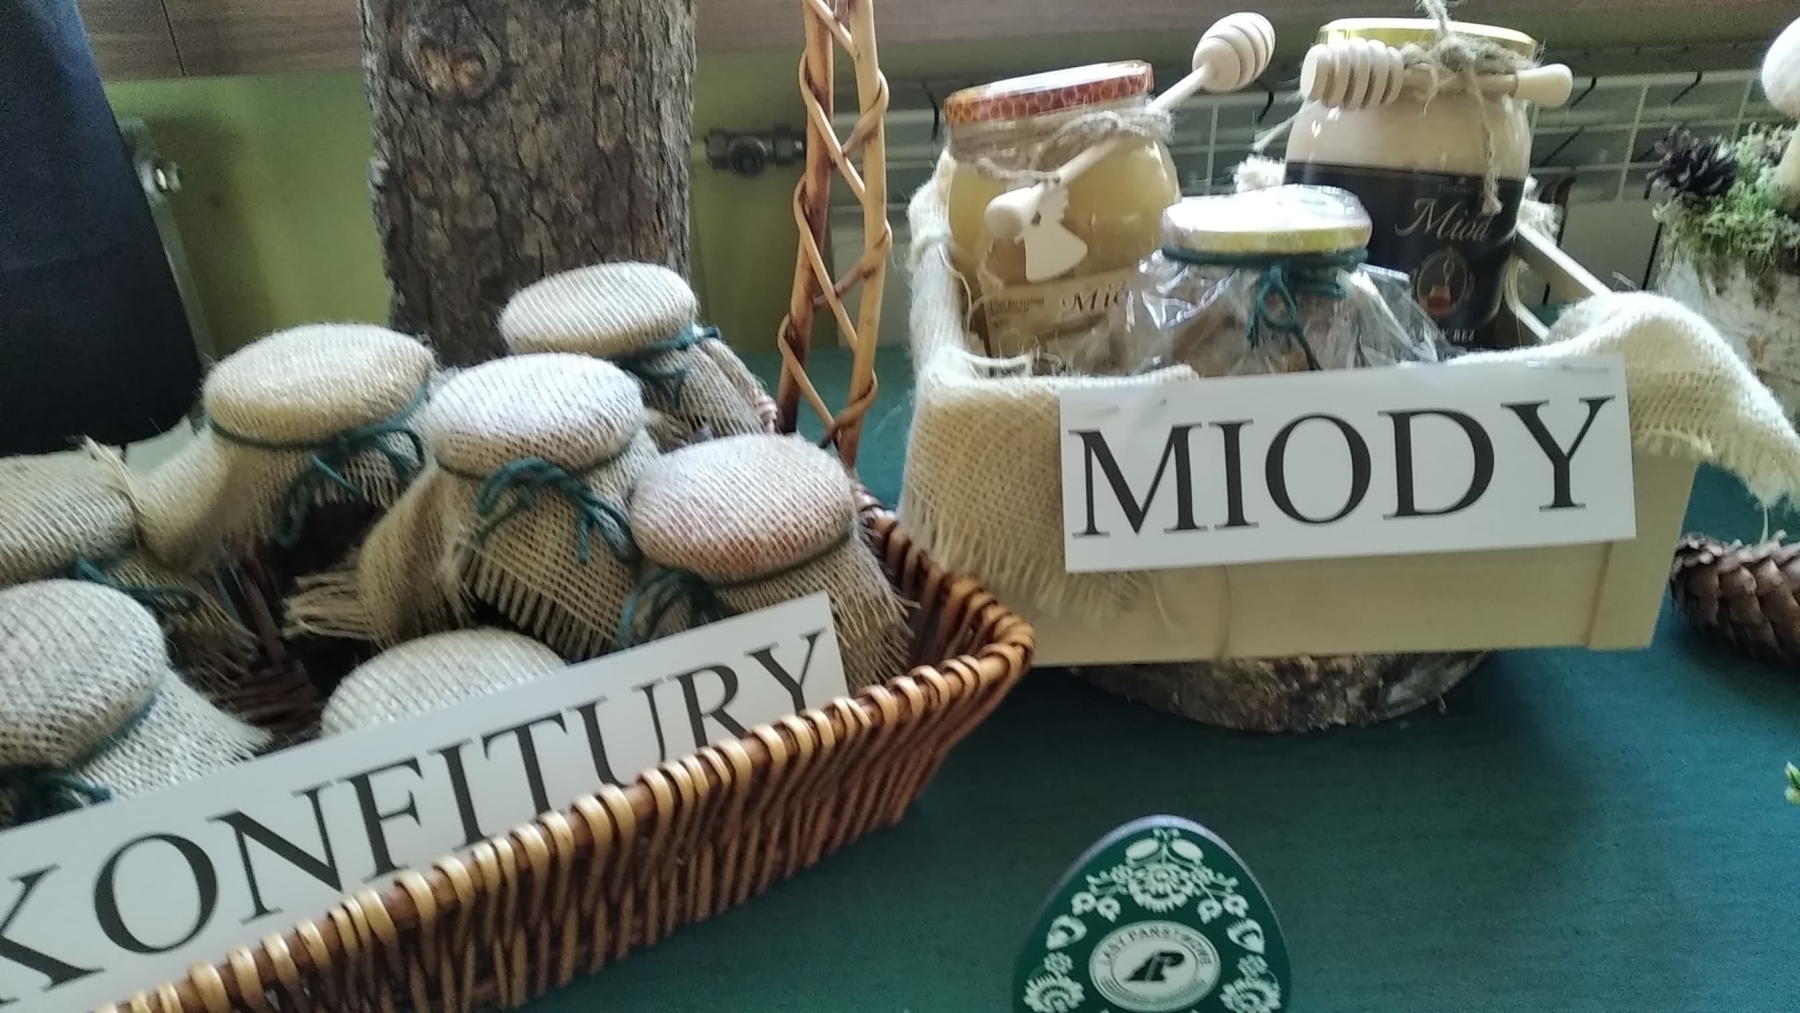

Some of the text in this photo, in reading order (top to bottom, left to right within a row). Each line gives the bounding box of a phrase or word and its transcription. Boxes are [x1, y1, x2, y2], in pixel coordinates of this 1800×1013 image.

[1061, 280, 1130, 313] Mió
[1068, 395, 1616, 538] MIODY
[0, 627, 827, 1006] KONFITURY
